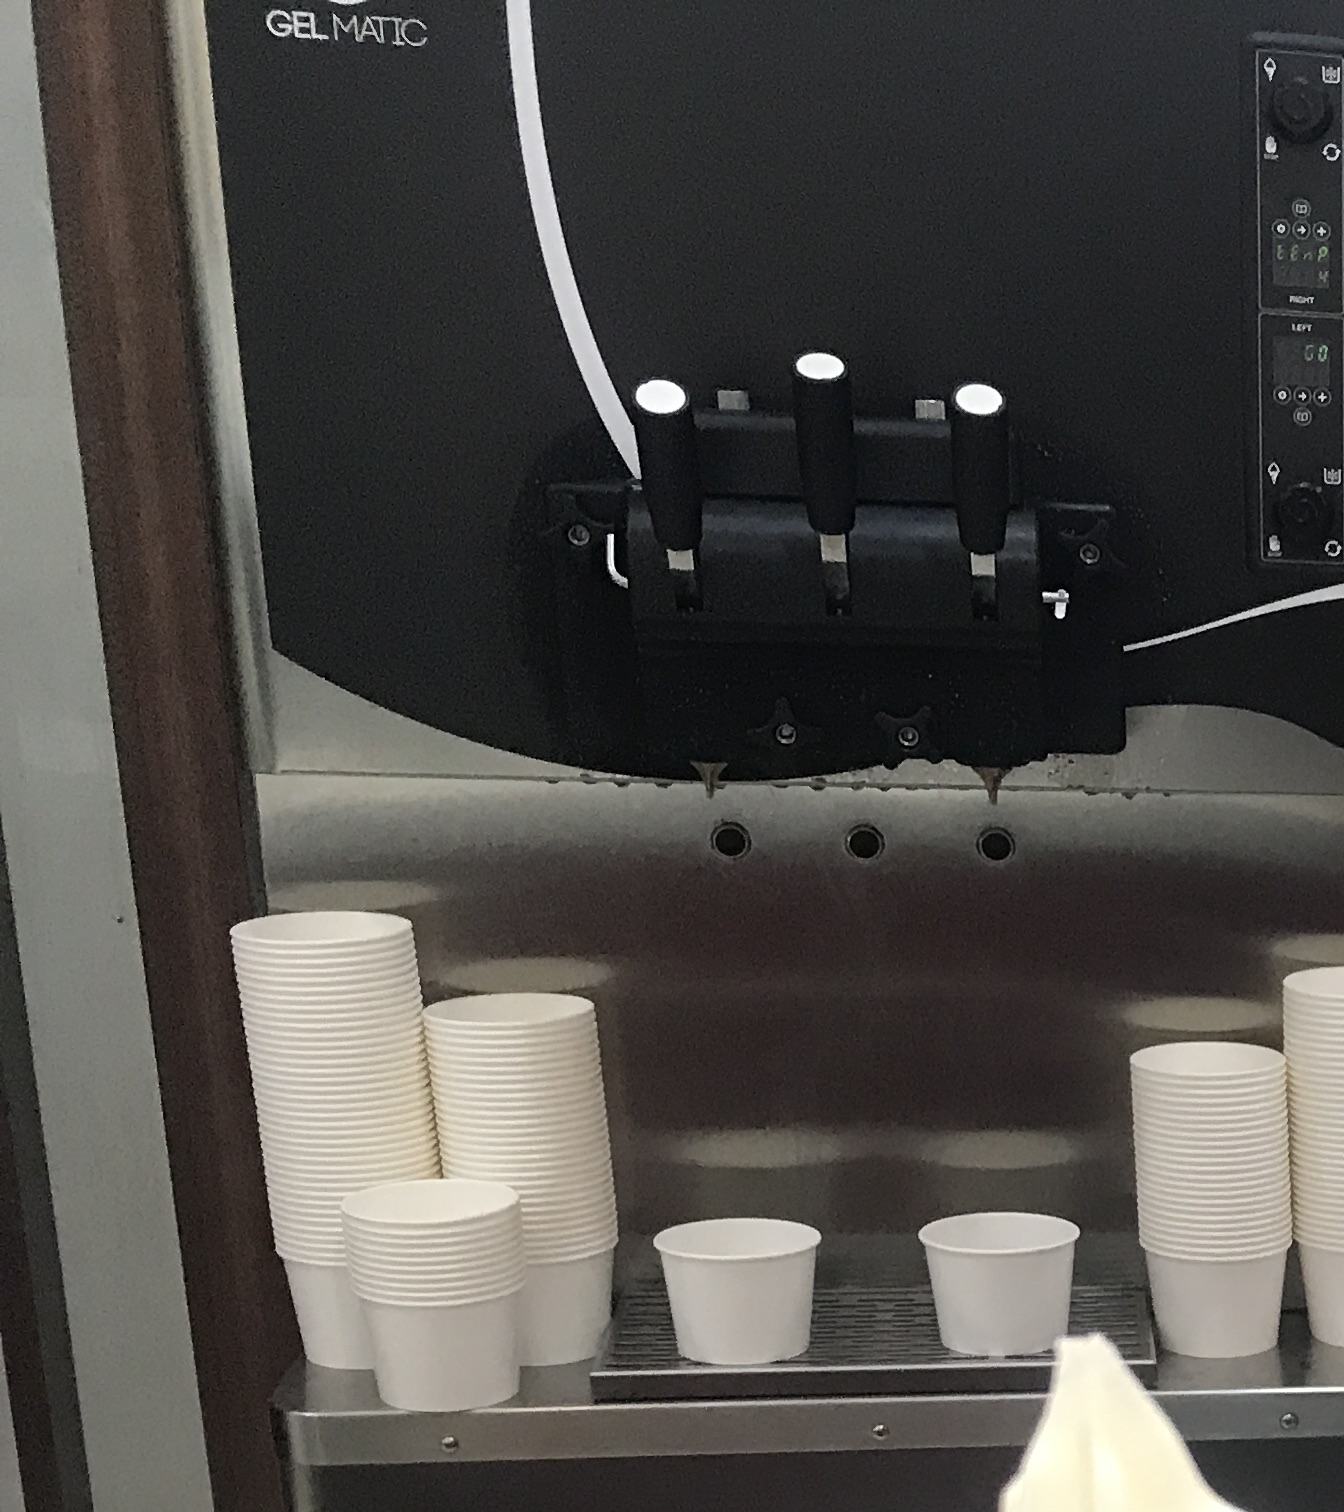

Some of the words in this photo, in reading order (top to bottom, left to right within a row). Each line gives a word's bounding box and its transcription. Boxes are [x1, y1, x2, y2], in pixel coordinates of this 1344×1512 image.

[265, 9, 329, 40] GEL
[332, 13, 428, 47] MATIC
[1291, 323, 1313, 332] LEFT
